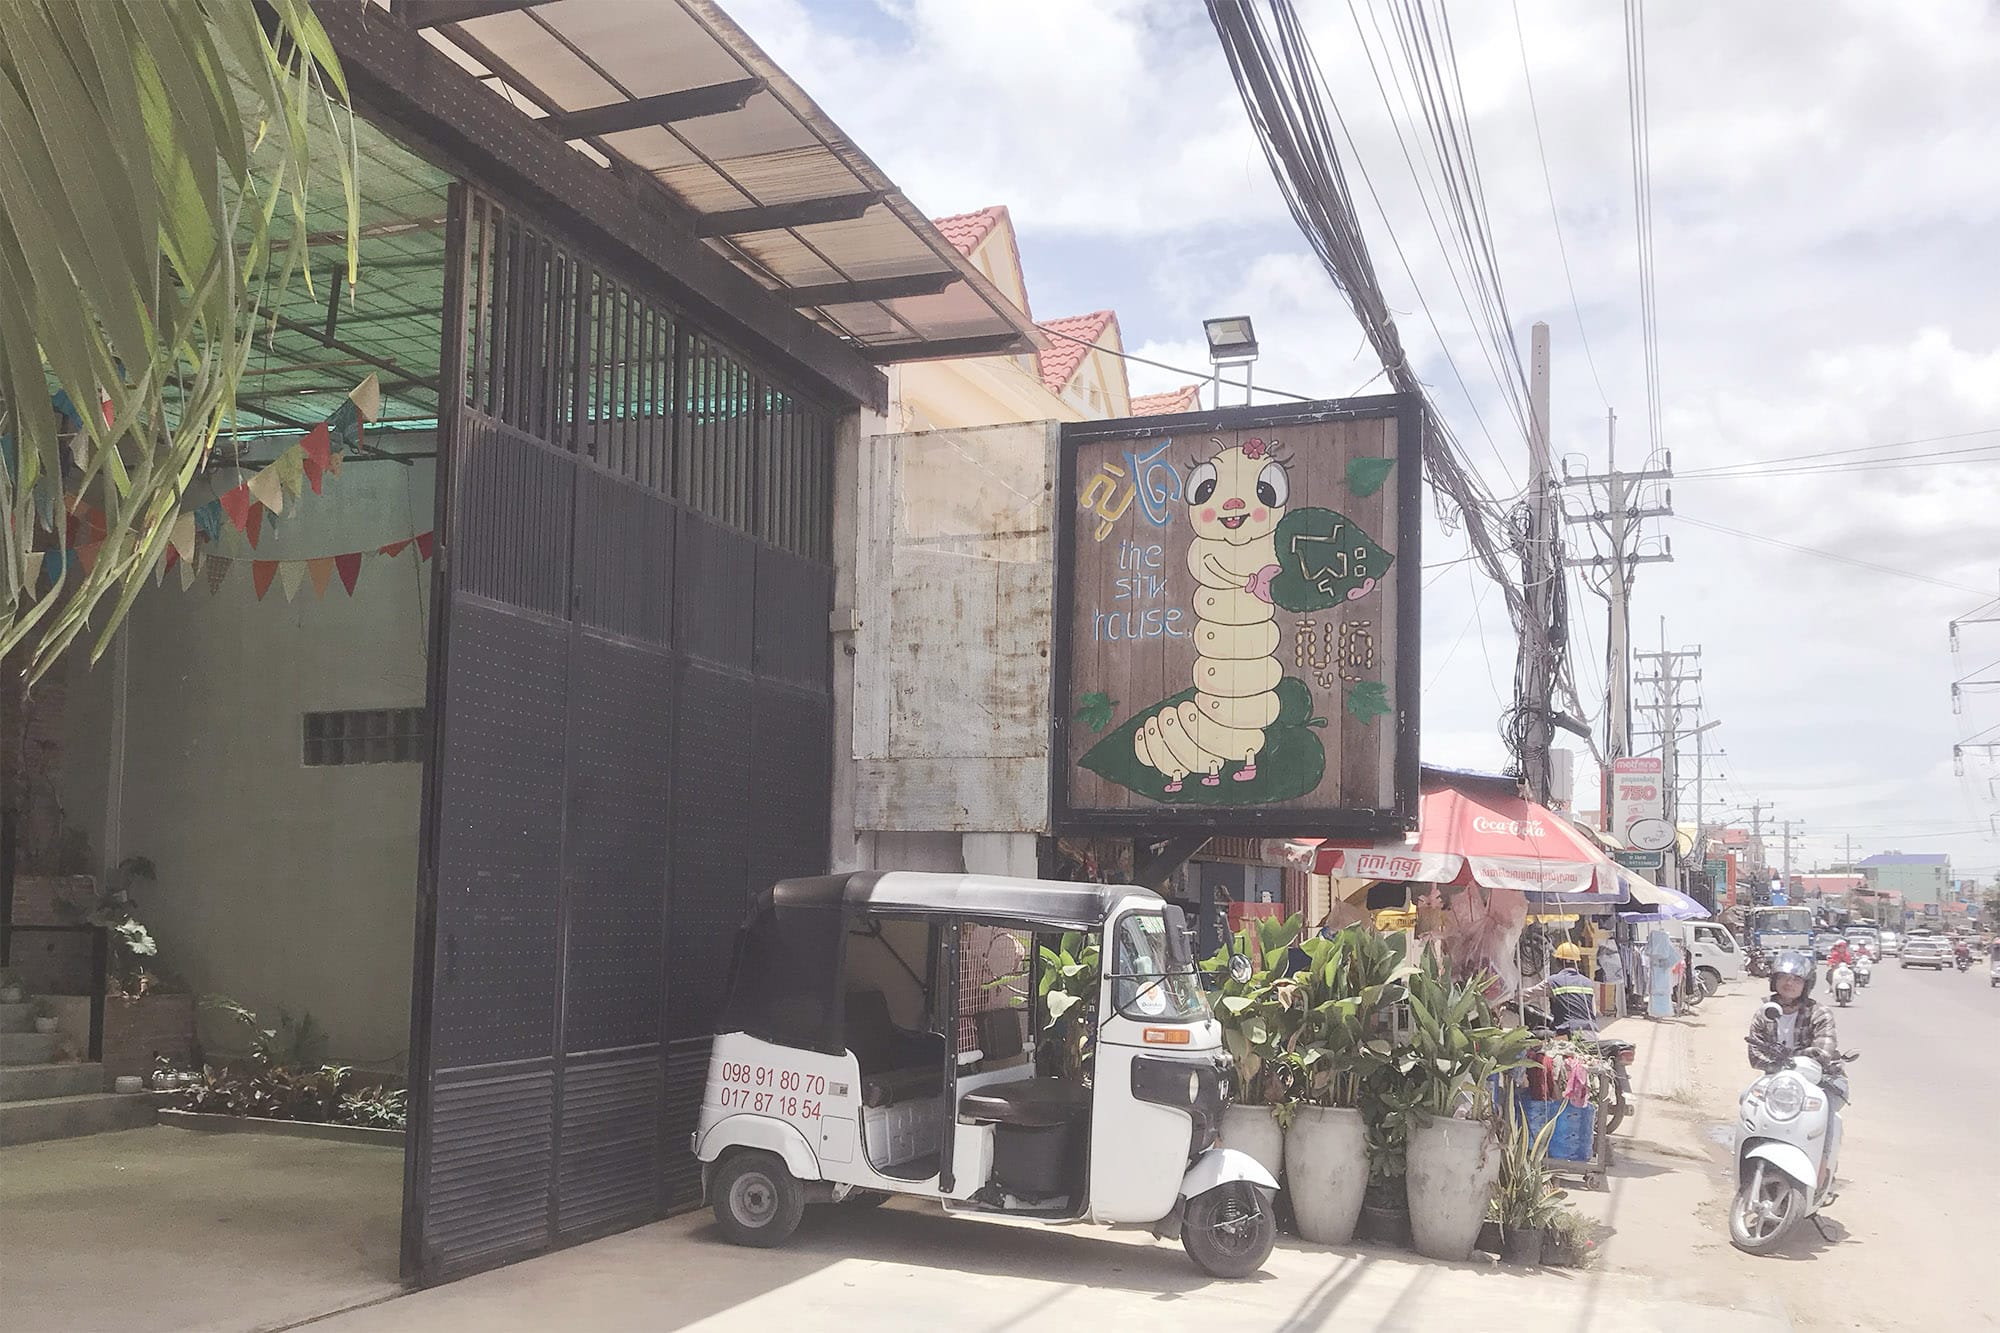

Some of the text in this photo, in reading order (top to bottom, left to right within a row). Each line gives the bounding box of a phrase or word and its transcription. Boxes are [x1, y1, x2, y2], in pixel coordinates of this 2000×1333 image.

[1119, 539, 1163, 570] the
[1619, 785, 1658, 801] 750
[1472, 815, 1546, 838] Coca-Cola
[722, 1062, 751, 1084] 098
[756, 1066, 774, 1087] 91
[780, 1070, 800, 1091] 80
[806, 1074, 825, 1095] 70
[721, 1087, 821, 1120] 017 87 18 54
